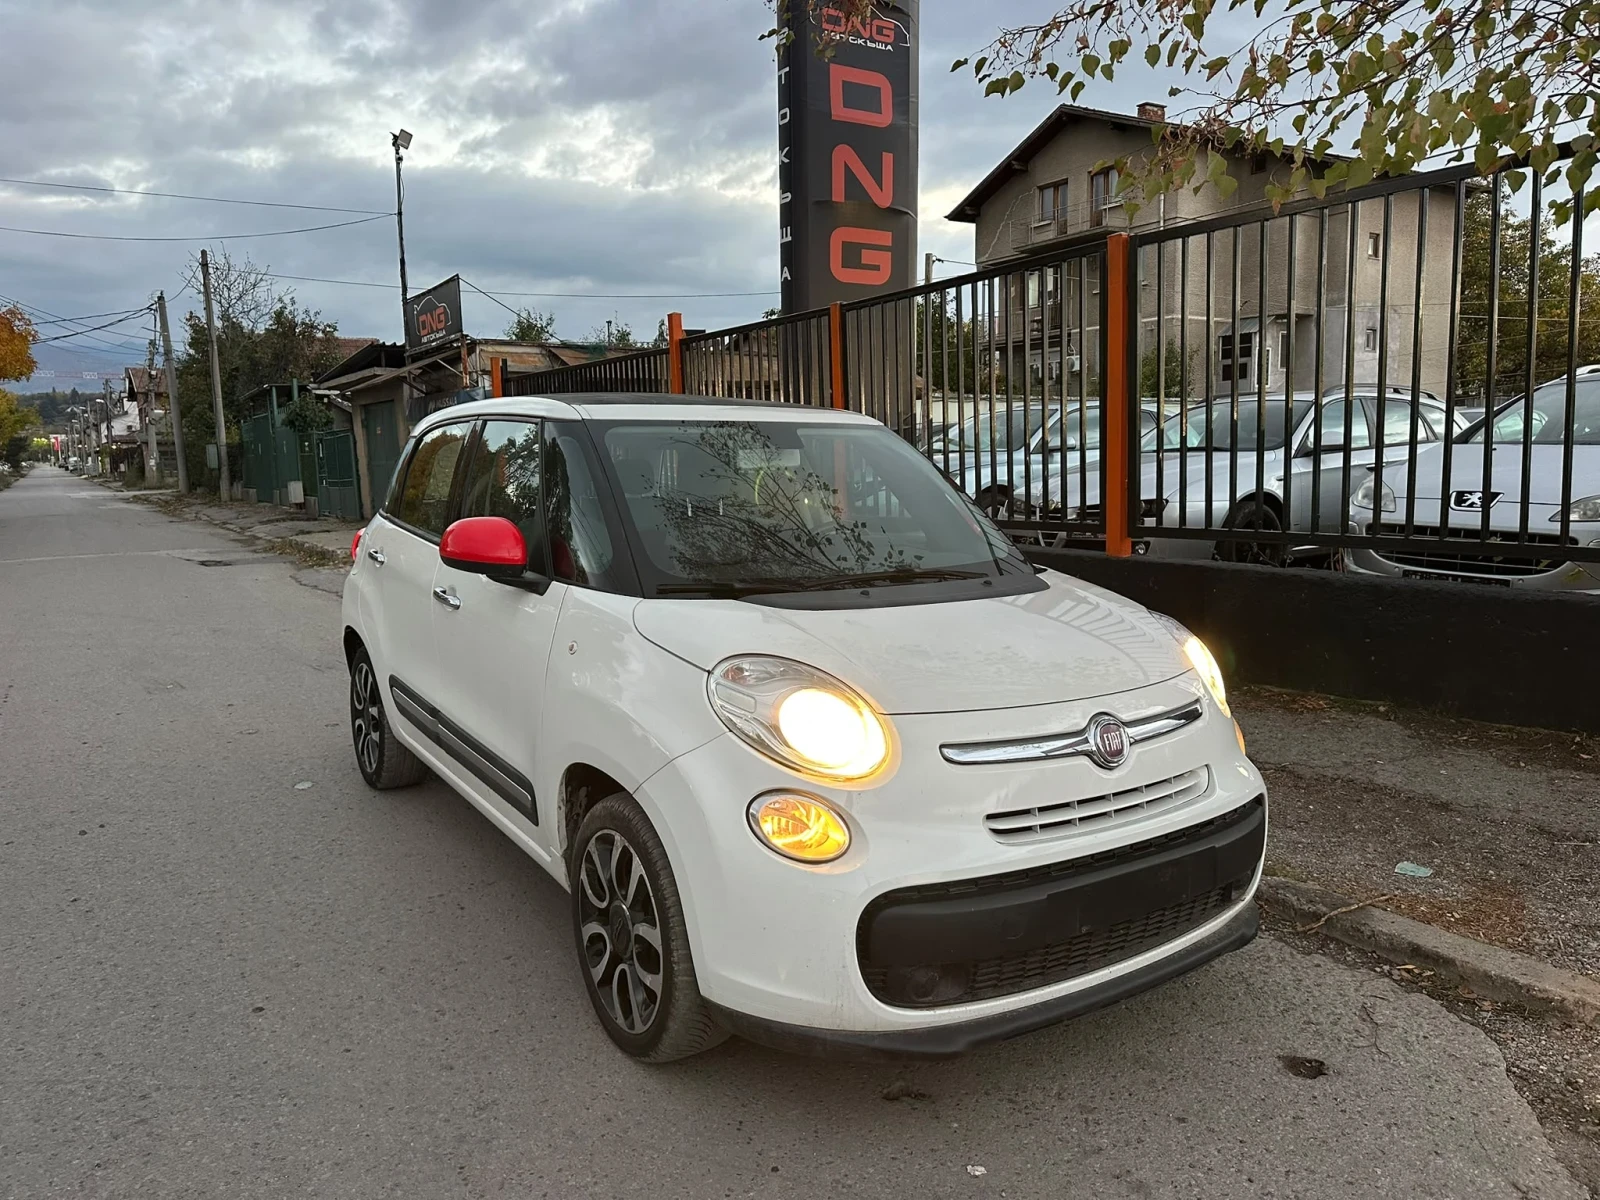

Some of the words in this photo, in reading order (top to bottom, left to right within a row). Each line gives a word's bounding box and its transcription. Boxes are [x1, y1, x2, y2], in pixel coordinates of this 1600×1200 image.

[822, 7, 895, 43] DNG
[829, 63, 894, 286] DNG
[418, 306, 446, 337] DNG
[1103, 731, 1122, 751] FIAT
